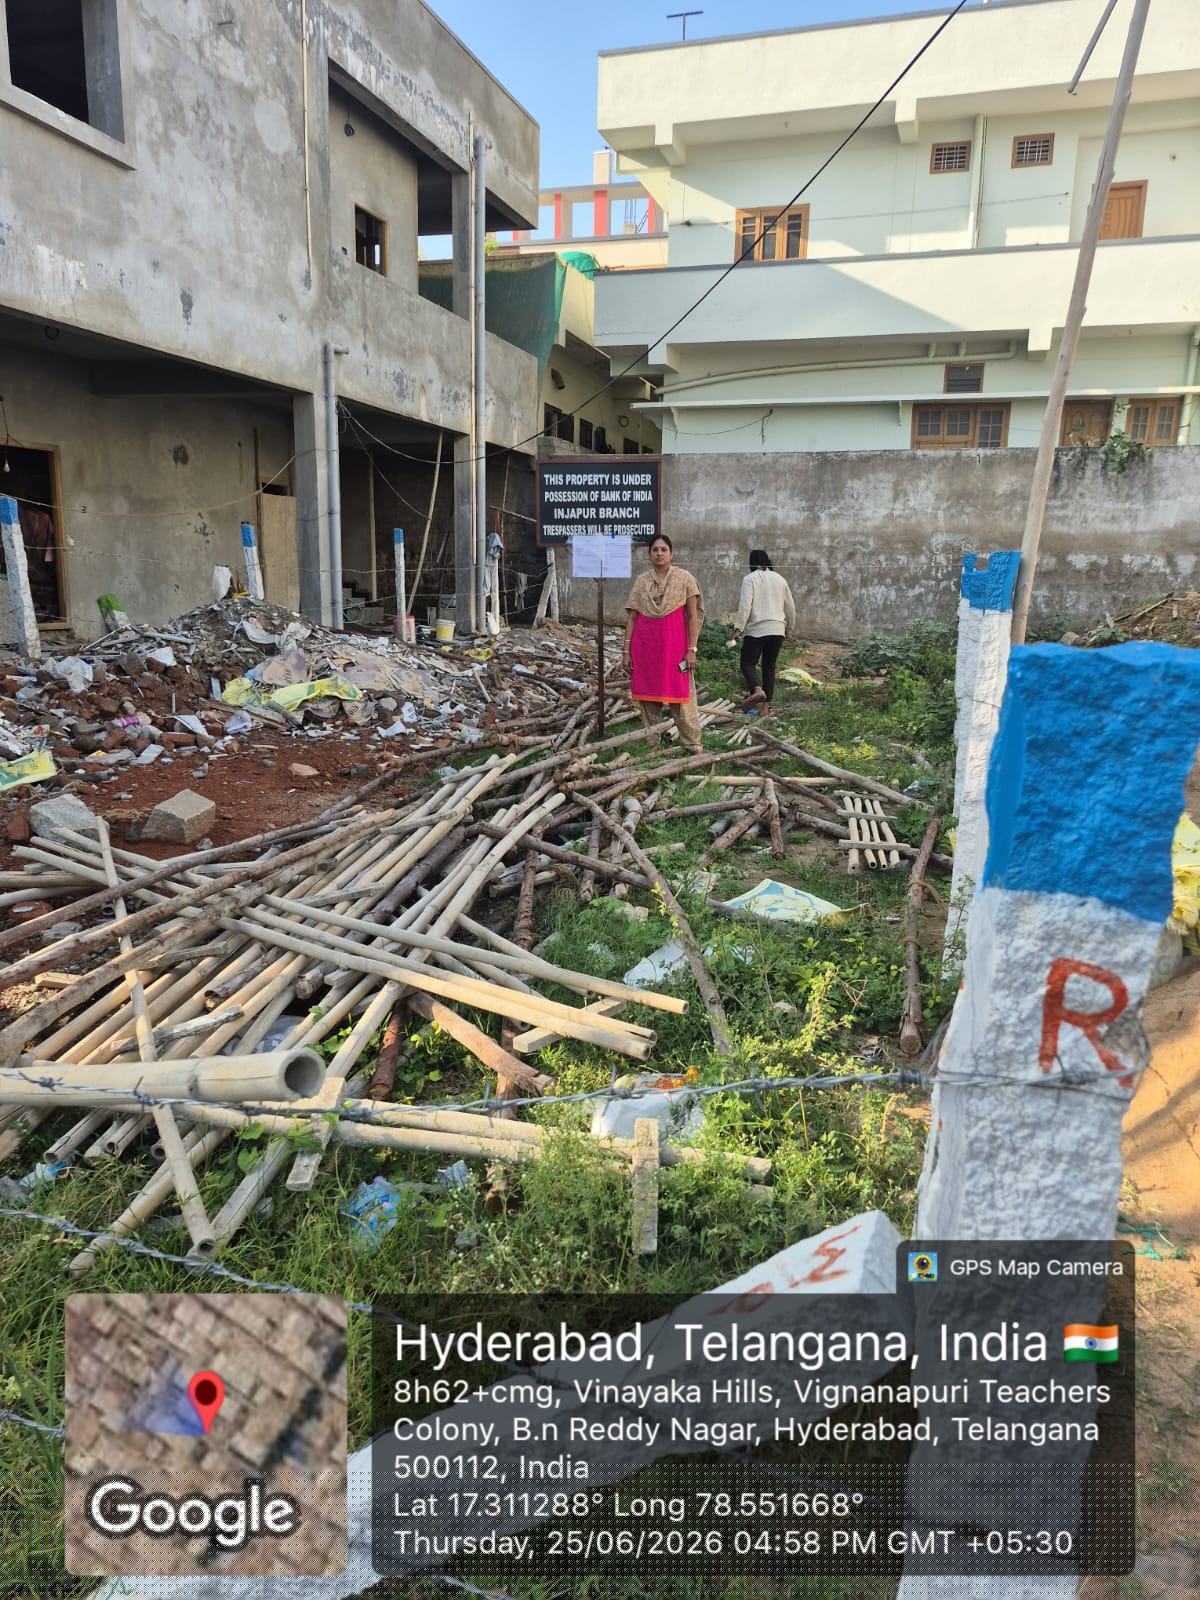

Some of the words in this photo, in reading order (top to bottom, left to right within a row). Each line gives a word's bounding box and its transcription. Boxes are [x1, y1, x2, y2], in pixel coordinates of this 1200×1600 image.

[544, 474, 563, 485] THIS
[565, 474, 609, 485] PROPERTY
[612, 474, 620, 485] IS
[622, 474, 651, 485] UNDER
[545, 491, 588, 502] POSSESSION
[590, 491, 599, 502] OF
[601, 491, 621, 502] BANK
[622, 491, 631, 502] OF
[633, 490, 652, 502] INDIA
[554, 508, 596, 519] INJAPUR
[599, 507, 640, 518] BRANCH
[543, 524, 586, 536] TRESPASSERS
[604, 524, 612, 535] BE
[613, 524, 655, 535] PROSECUTED
[1038, 957, 1134, 1089] R
